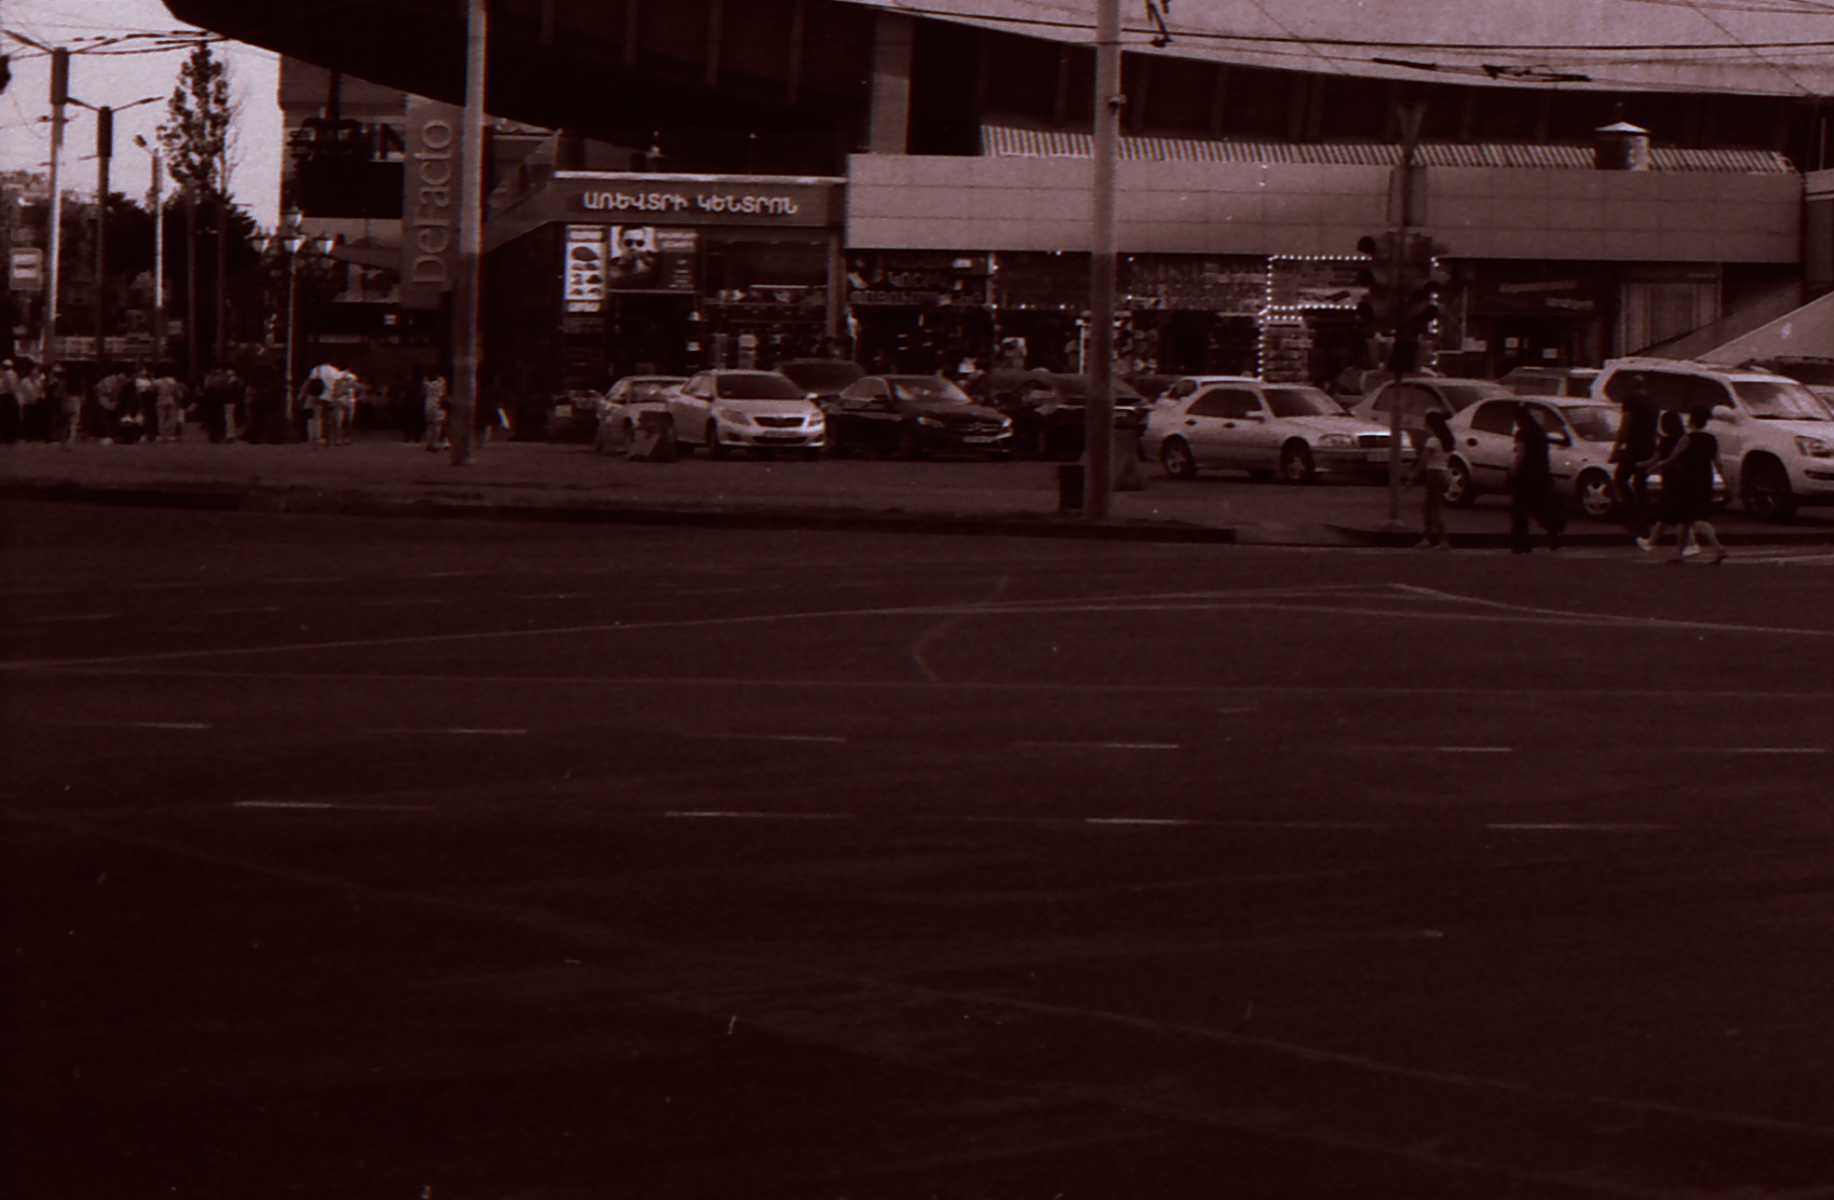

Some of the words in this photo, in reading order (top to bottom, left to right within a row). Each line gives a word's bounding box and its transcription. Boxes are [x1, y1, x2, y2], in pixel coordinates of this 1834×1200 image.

[411, 120, 449, 283] DeFacto
[583, 191, 689, 211] ԱՌԵՎՏՐԻ
[697, 194, 799, 215] ԿԵՆՏՐՈՆ
